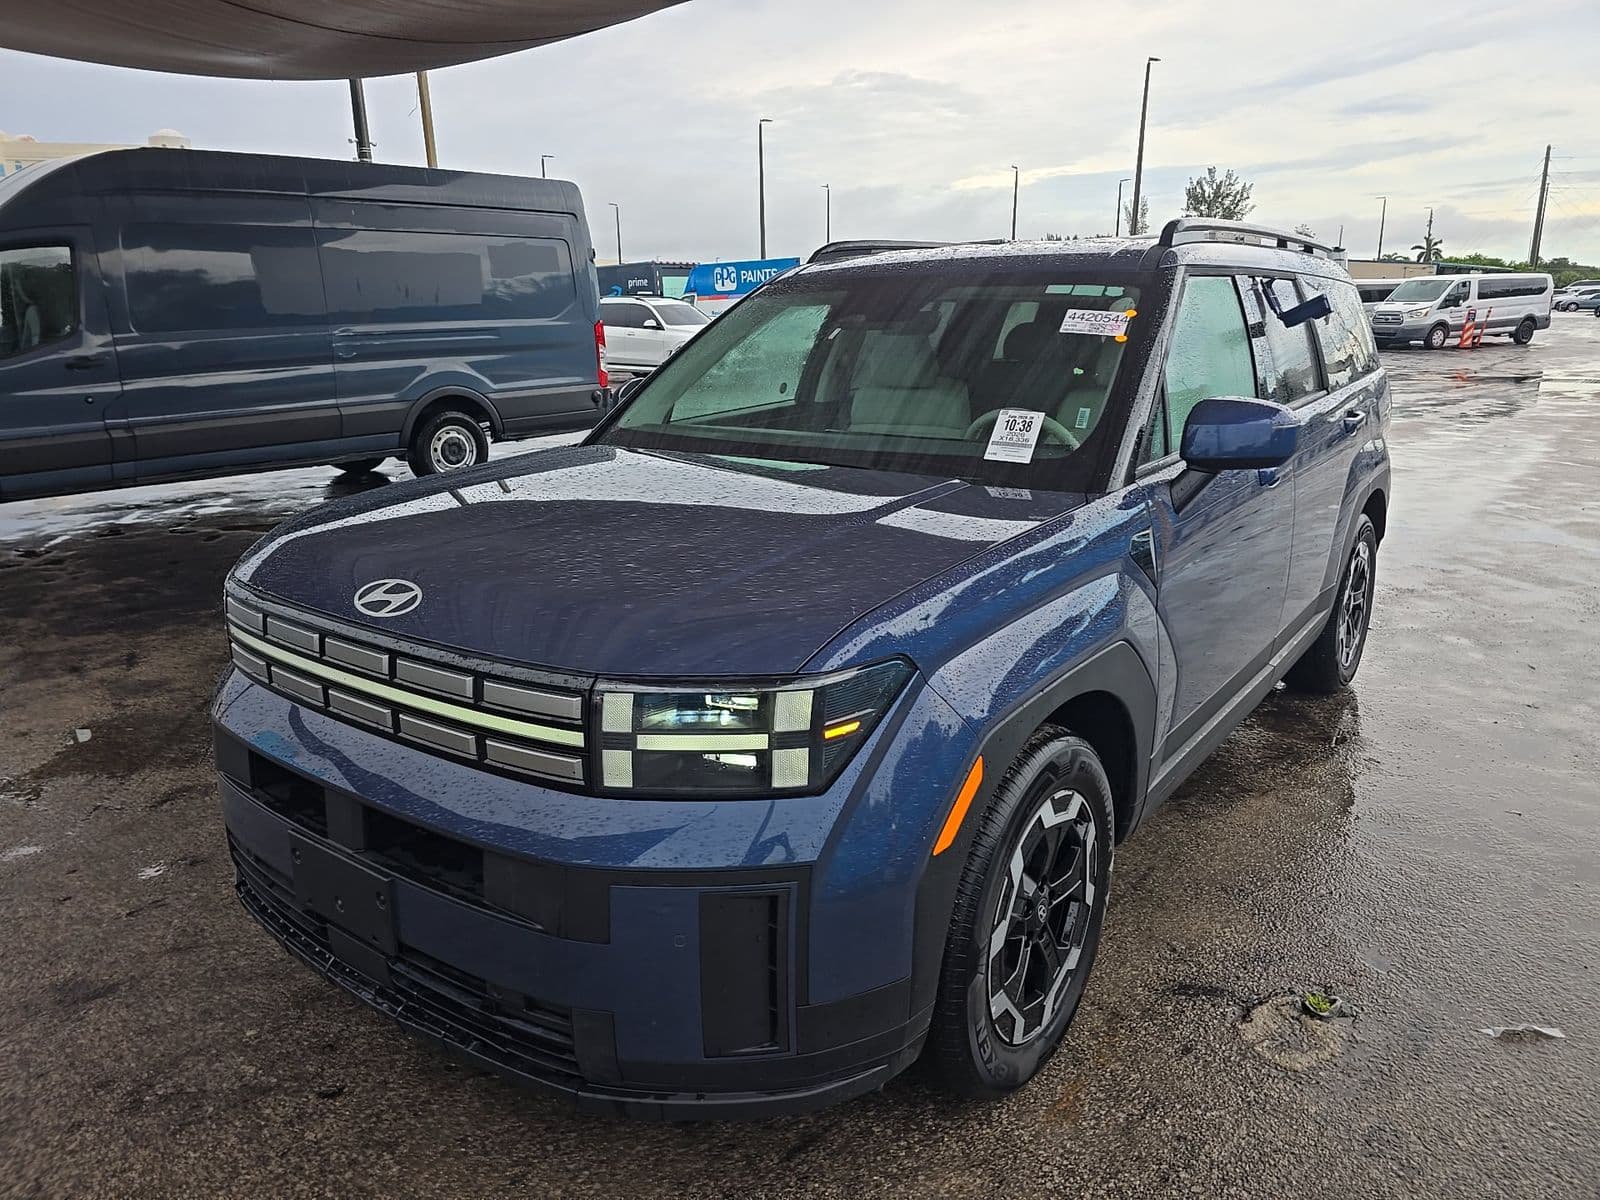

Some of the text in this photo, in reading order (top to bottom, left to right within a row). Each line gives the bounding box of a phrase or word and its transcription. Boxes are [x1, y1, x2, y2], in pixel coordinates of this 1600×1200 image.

[627, 277, 649, 289] prime
[715, 267, 778, 288] PPG PAINTS
[1068, 312, 1131, 324] 4420544
[1004, 419, 1033, 433] 10:38
